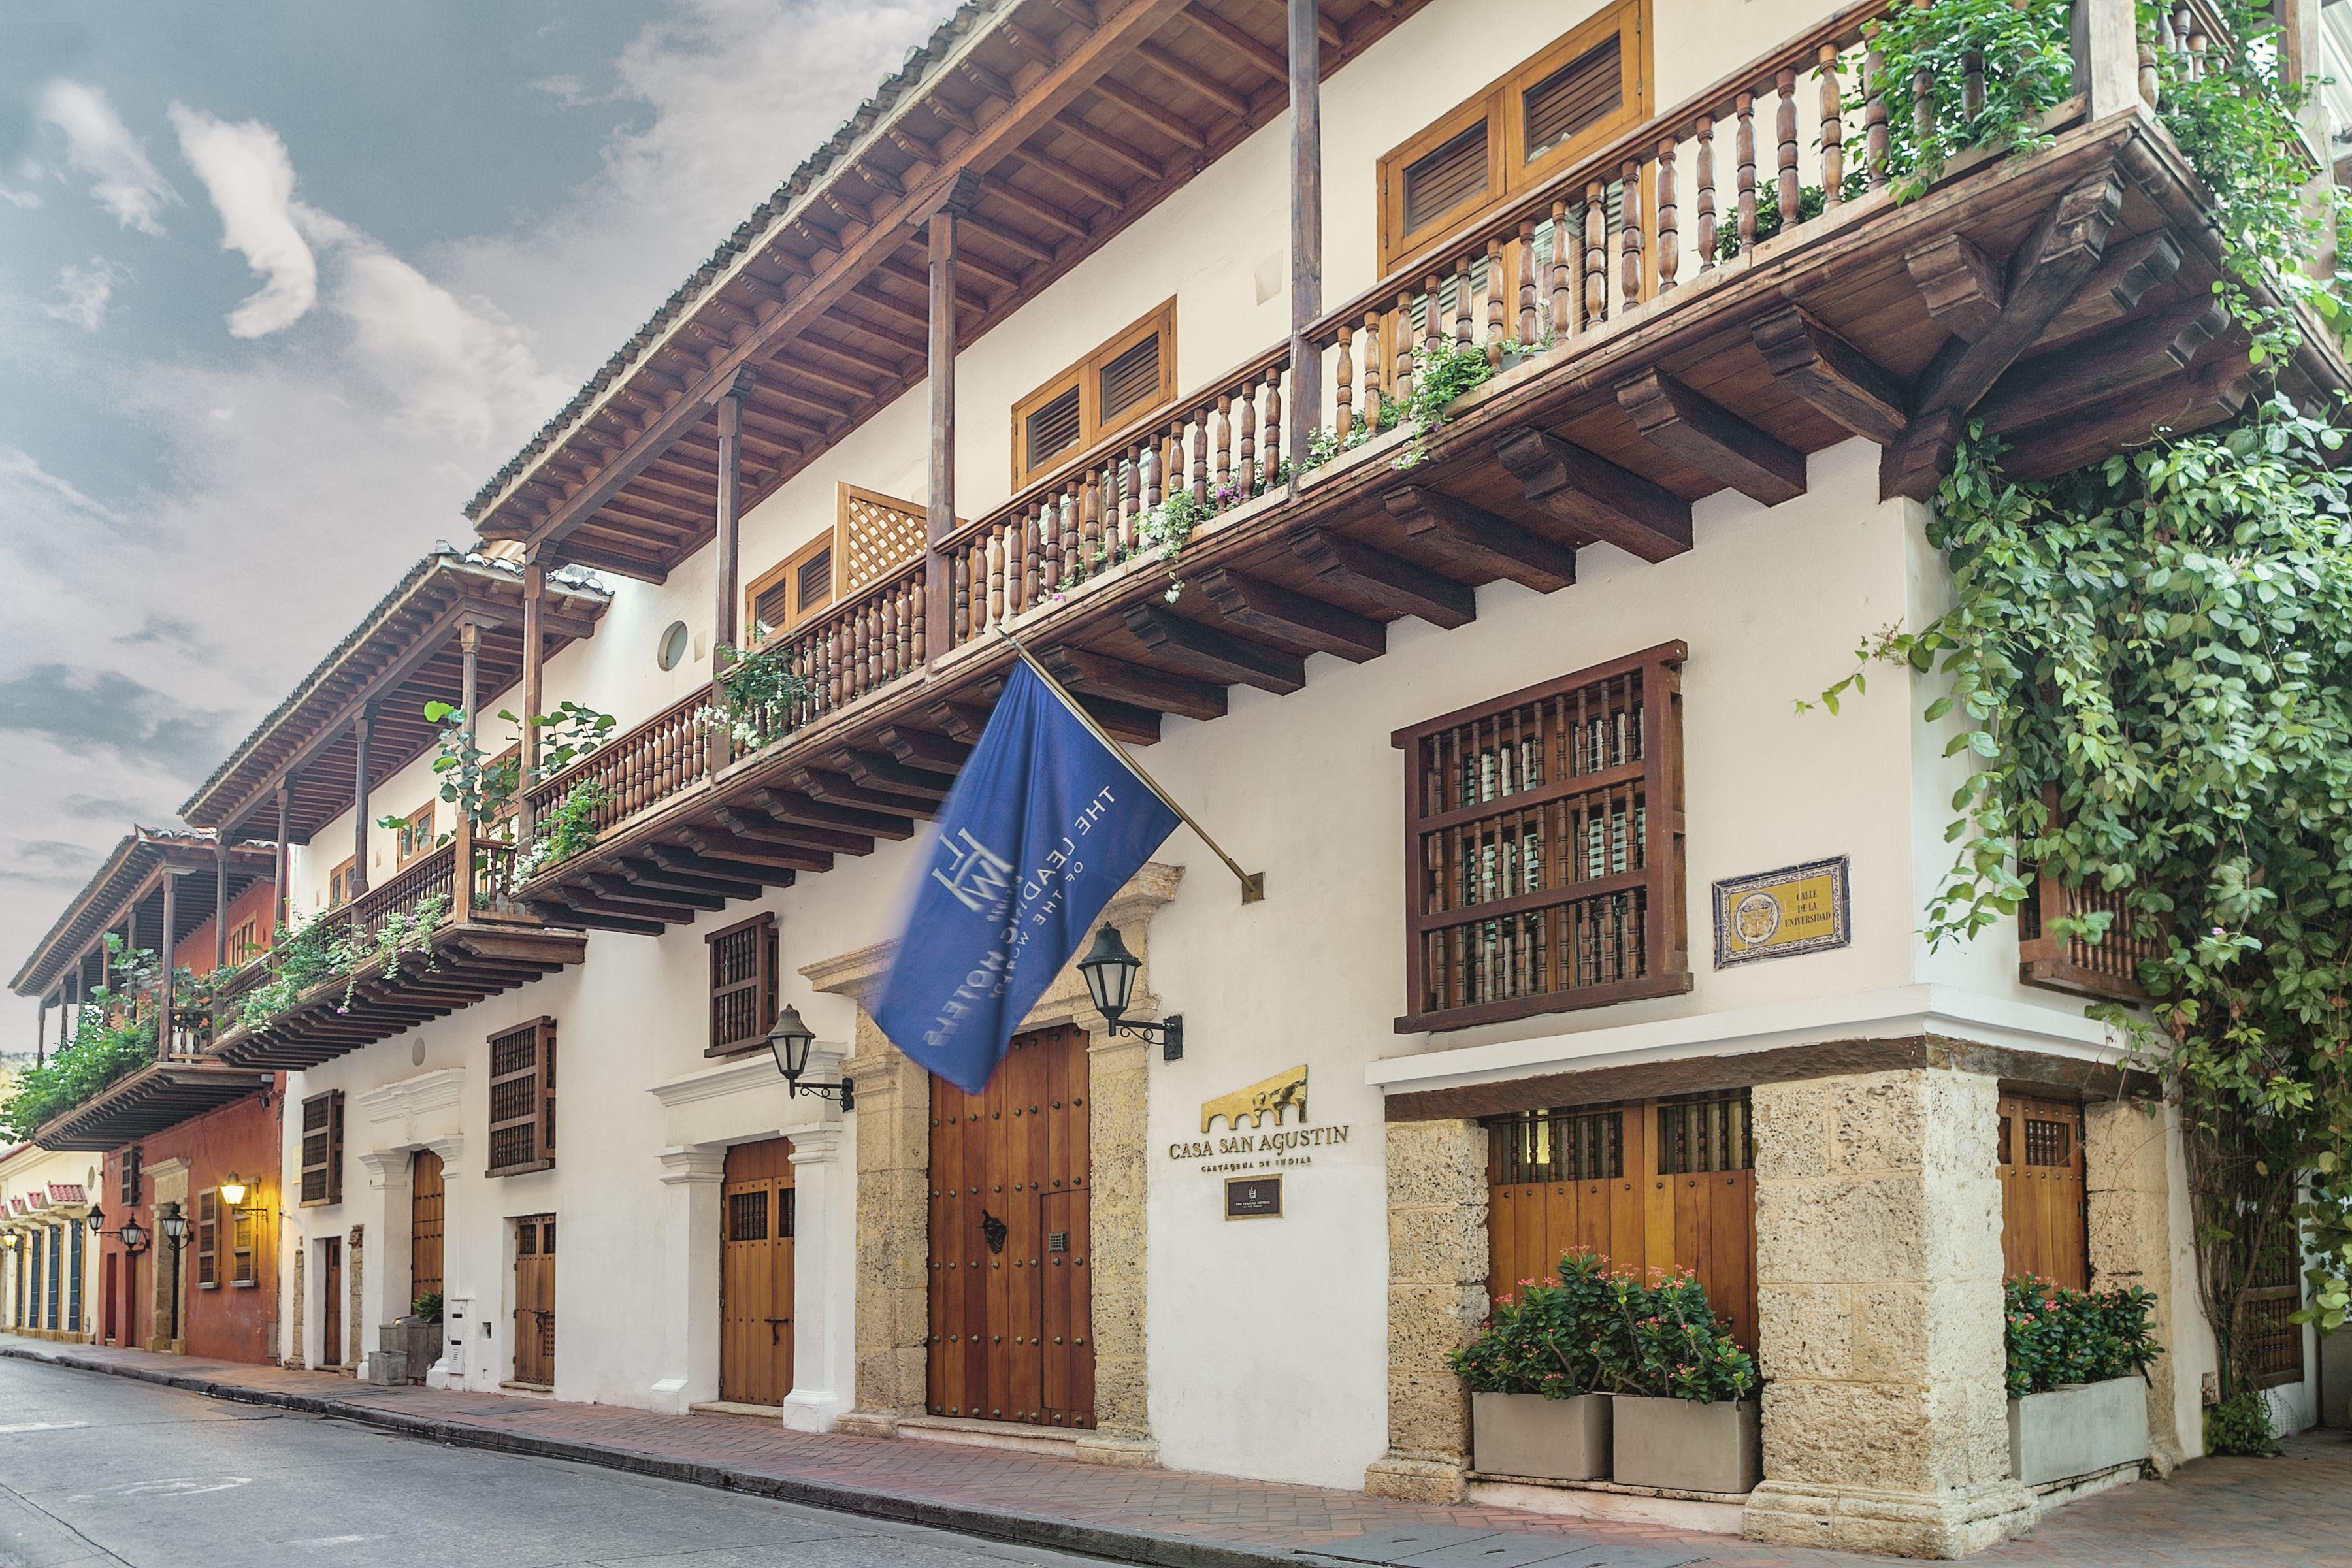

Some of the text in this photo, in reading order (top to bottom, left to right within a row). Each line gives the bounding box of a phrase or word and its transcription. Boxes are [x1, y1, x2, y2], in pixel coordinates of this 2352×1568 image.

[1797, 890, 1817, 901] CALLE
[1798, 902, 1817, 913] DE LA
[1785, 912, 1830, 927] UNIVERSIDAD
[1169, 1125, 1350, 1160] CASA SAN AGUSTIN
[1201, 1162, 1254, 1173] CARTAGENA
[1275, 1156, 1311, 1166] INDIAS
